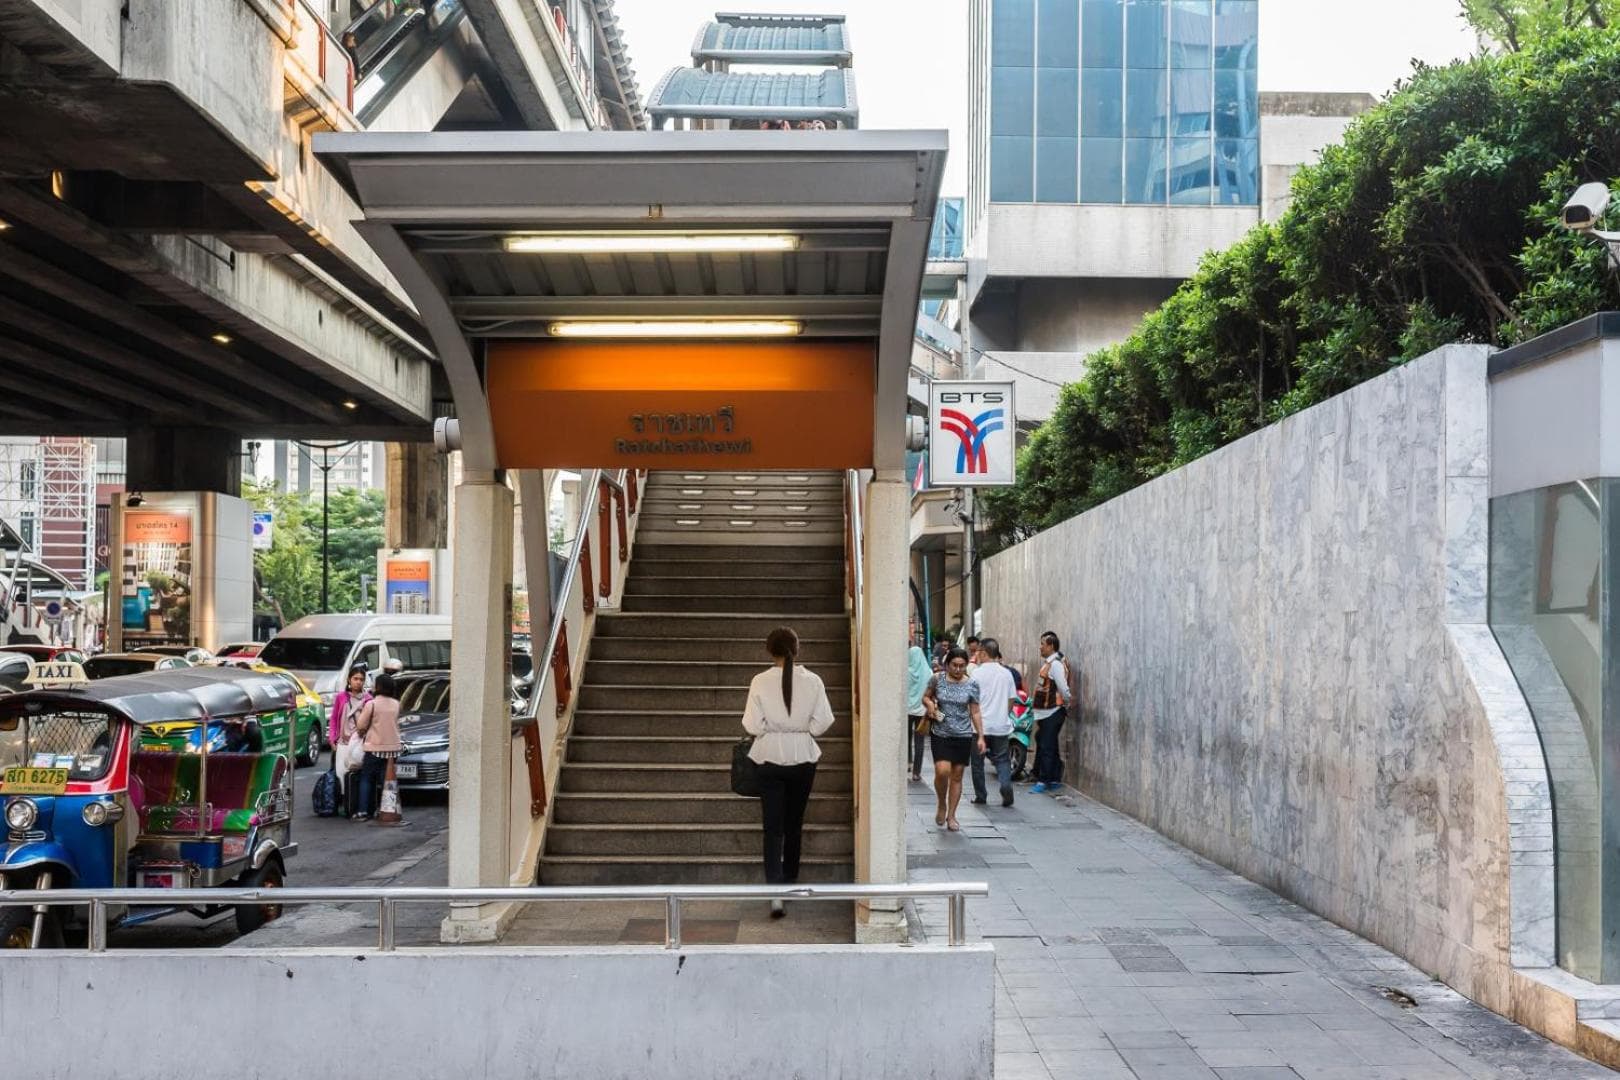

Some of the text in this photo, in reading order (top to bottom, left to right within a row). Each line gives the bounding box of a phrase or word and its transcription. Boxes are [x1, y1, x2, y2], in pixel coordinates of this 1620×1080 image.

[941, 392, 1004, 403] BTS
[630, 405, 734, 433] ราชเทวี
[615, 438, 752, 453] Ratchathewi
[36, 665, 72, 678] TAXI
[31, 769, 65, 784] 6275
